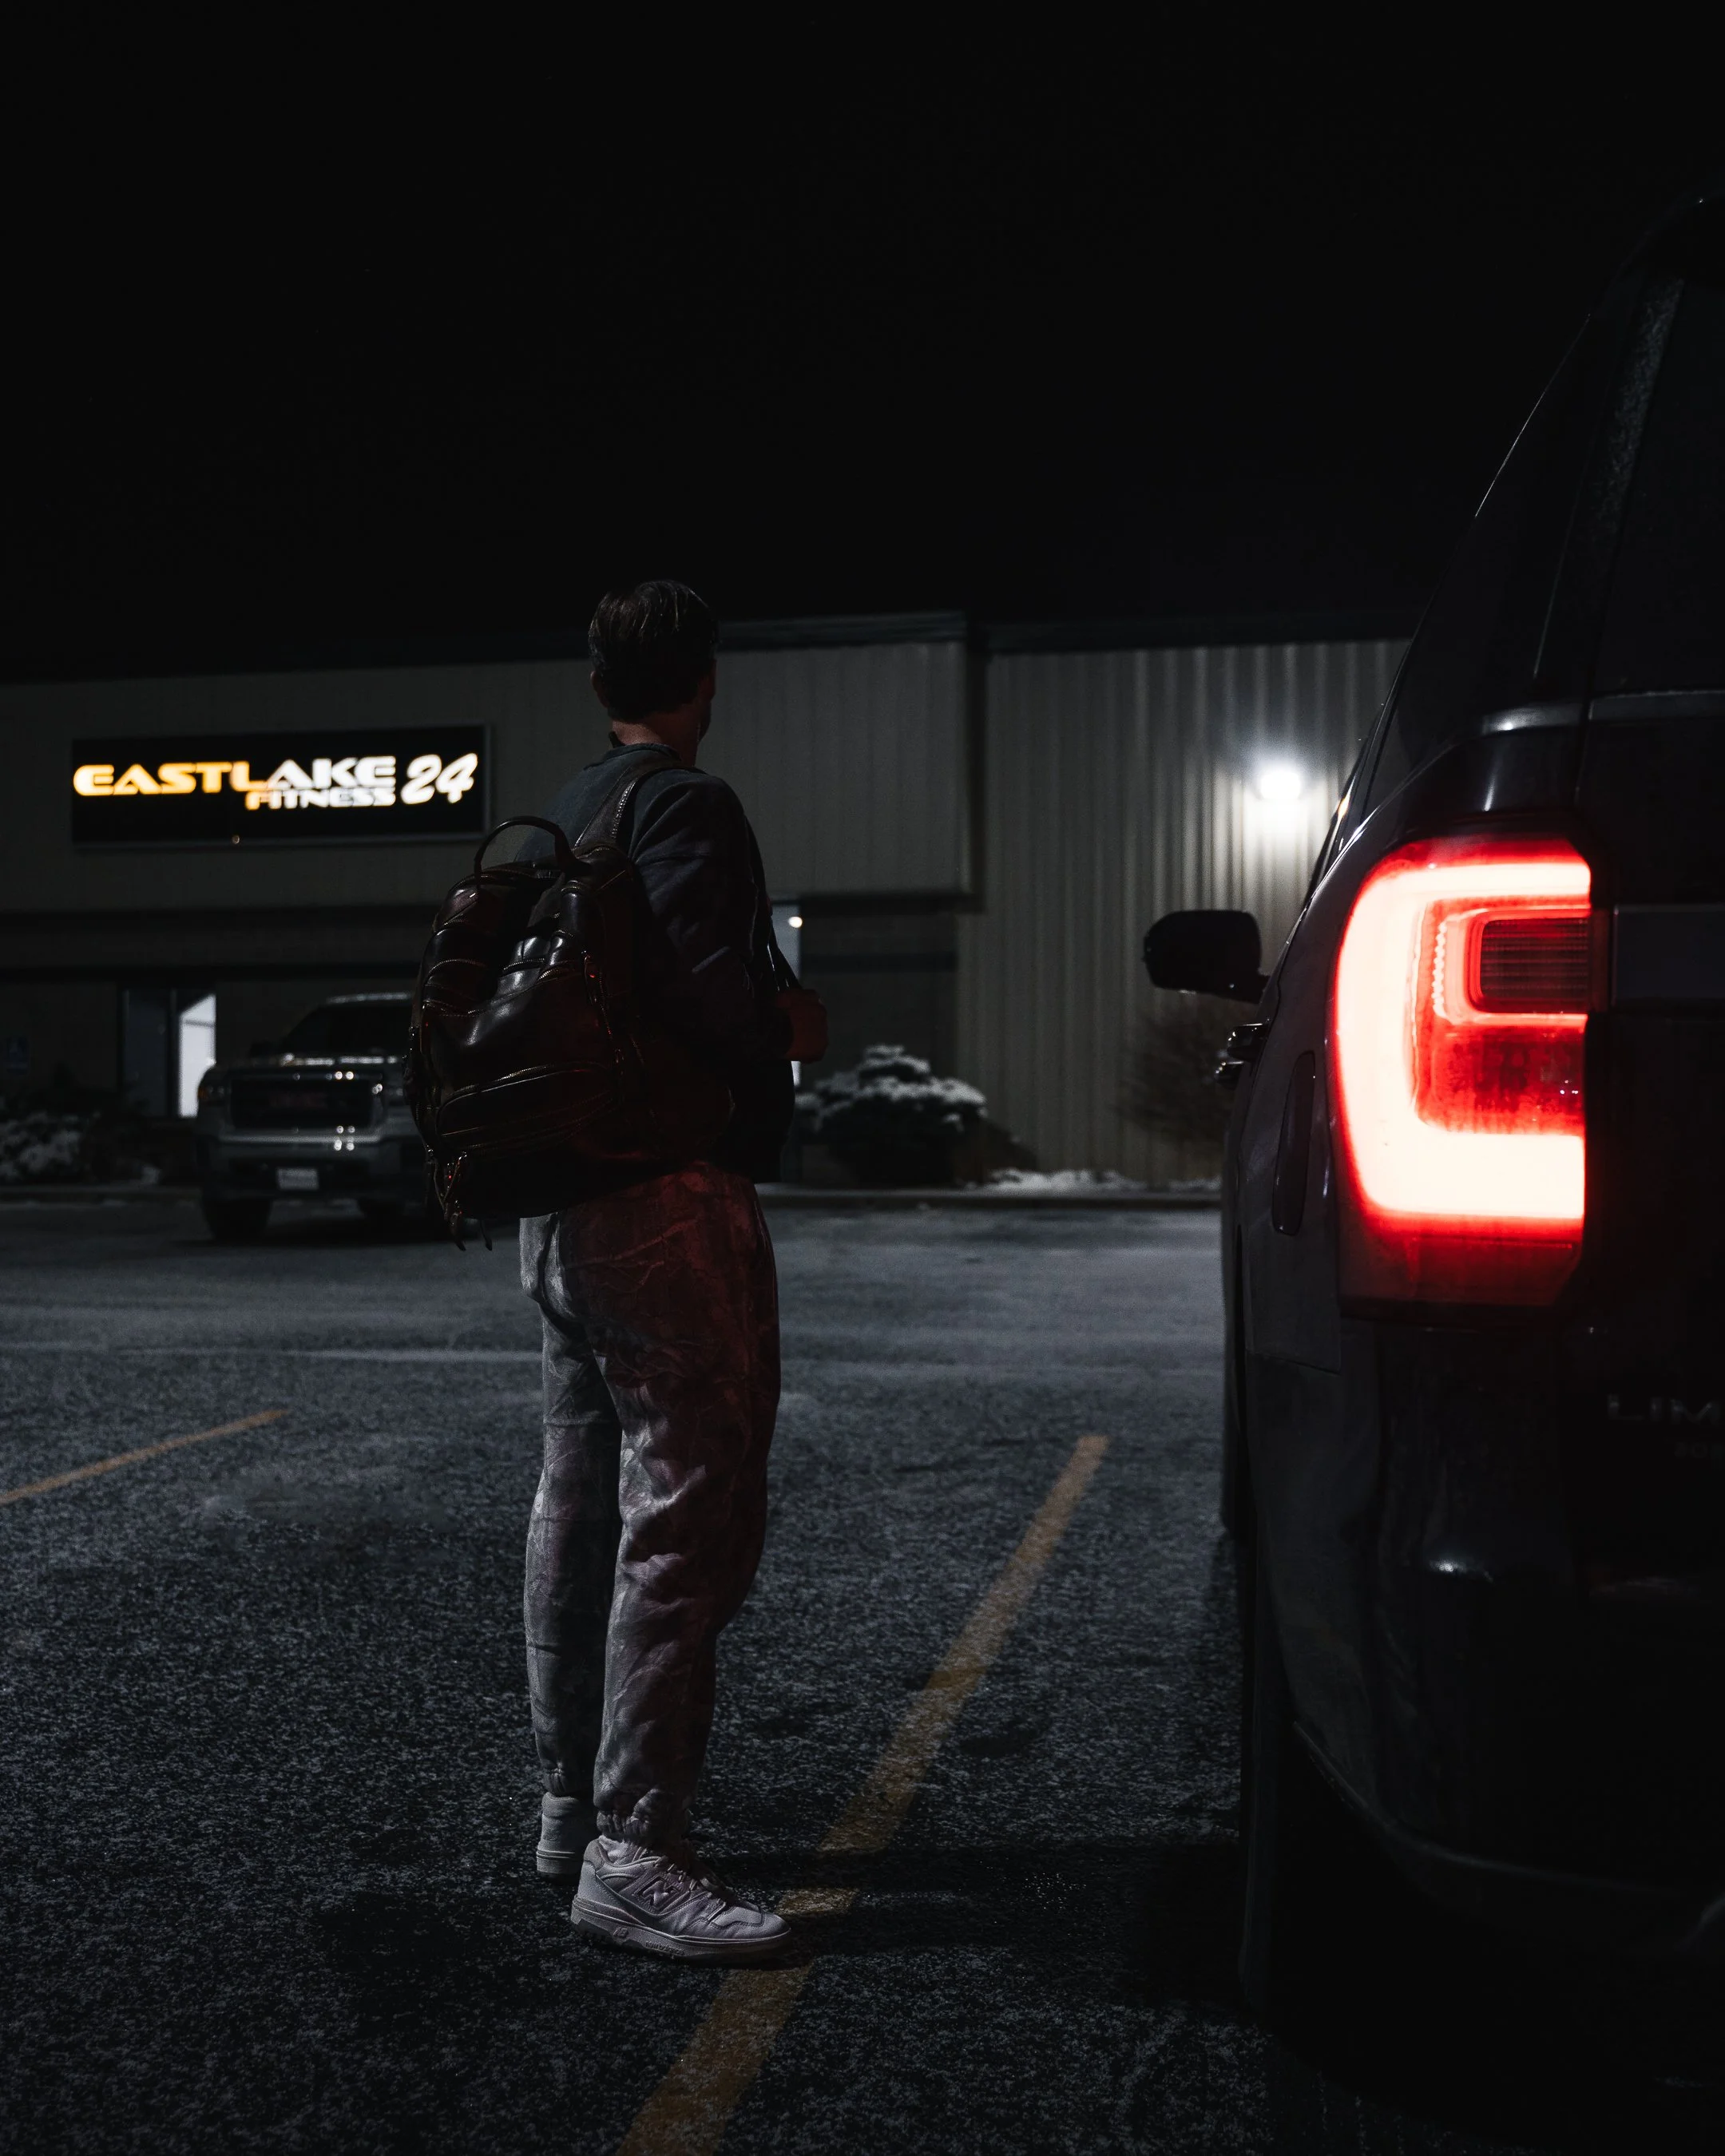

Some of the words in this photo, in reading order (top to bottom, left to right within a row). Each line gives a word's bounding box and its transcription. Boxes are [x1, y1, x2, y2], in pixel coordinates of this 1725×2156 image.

[73, 755, 397, 796] EASTLAKE
[400, 752, 478, 804] 24
[244, 788, 396, 810] FITNESS
